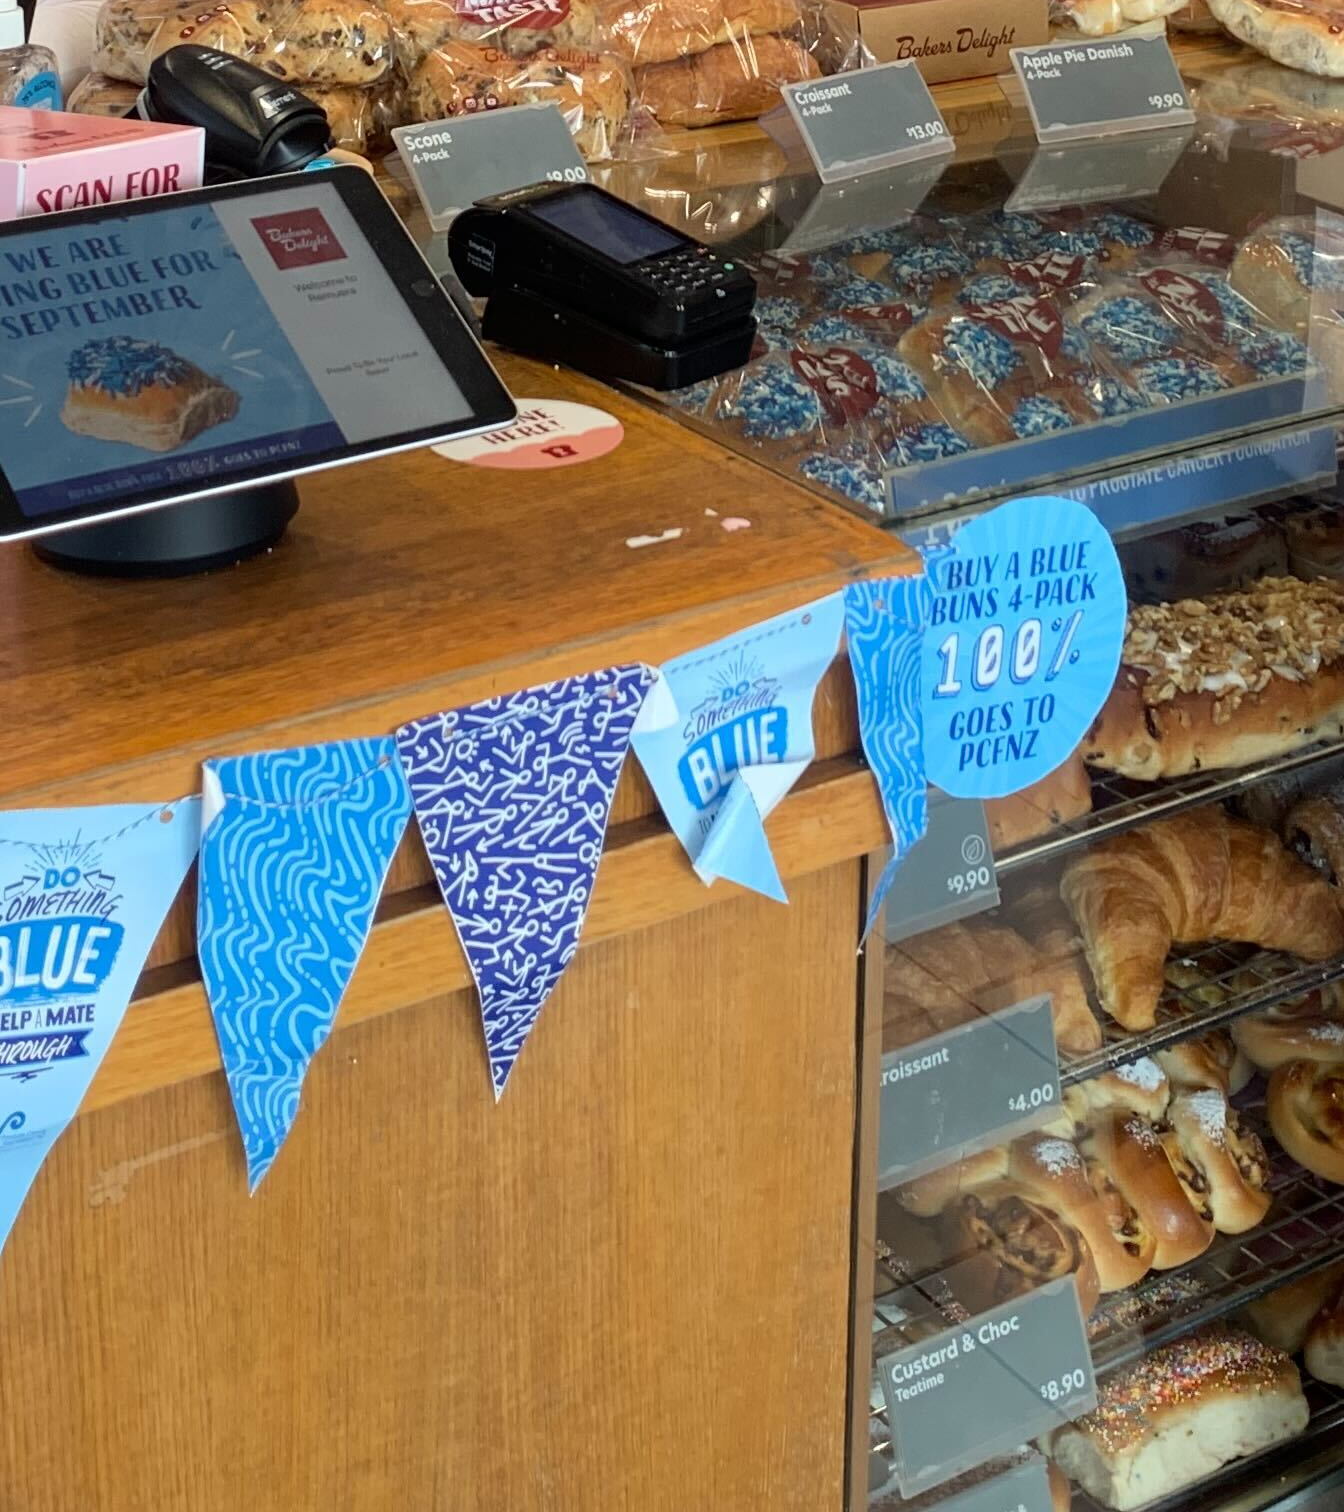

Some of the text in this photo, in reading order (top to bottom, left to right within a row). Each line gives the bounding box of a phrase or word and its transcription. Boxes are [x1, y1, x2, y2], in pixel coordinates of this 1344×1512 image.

[896, 26, 1016, 61] Bakers Delight
[1022, 44, 1134, 71] Apple Pie Danish
[1026, 68, 1062, 80] 4-Pack
[795, 82, 852, 105] Croissant
[1148, 93, 1184, 108] $9.90
[802, 103, 832, 118] 4-Pack
[403, 130, 452, 151] Scone
[906, 120, 944, 140] $13.00
[412, 148, 450, 166] 4-Pack
[36, 164, 182, 214] SCAN FOR
[4, 234, 132, 274] WE ARE
[69, 262, 149, 296] BLUE
[154, 249, 220, 280] FOR
[0, 285, 204, 341] SEPTEMBER
[947, 540, 1091, 591] BUY A BLUE
[931, 572, 1098, 626] BUNS 4-PACK
[932, 608, 1085, 699] 100%
[722, 680, 750, 702] DO
[950, 692, 1056, 740] GOES TO
[688, 711, 779, 804] BLUE
[958, 728, 1041, 772] PCFNZ
[43, 866, 81, 890] DO
[946, 867, 990, 894] $9.90
[45, 1002, 96, 1028] MATE
[1008, 1083, 1054, 1112] $4.00
[890, 1312, 1022, 1386] Custard Choc
[894, 1370, 946, 1404] Teatime
[1040, 1370, 1086, 1402] $8.90
